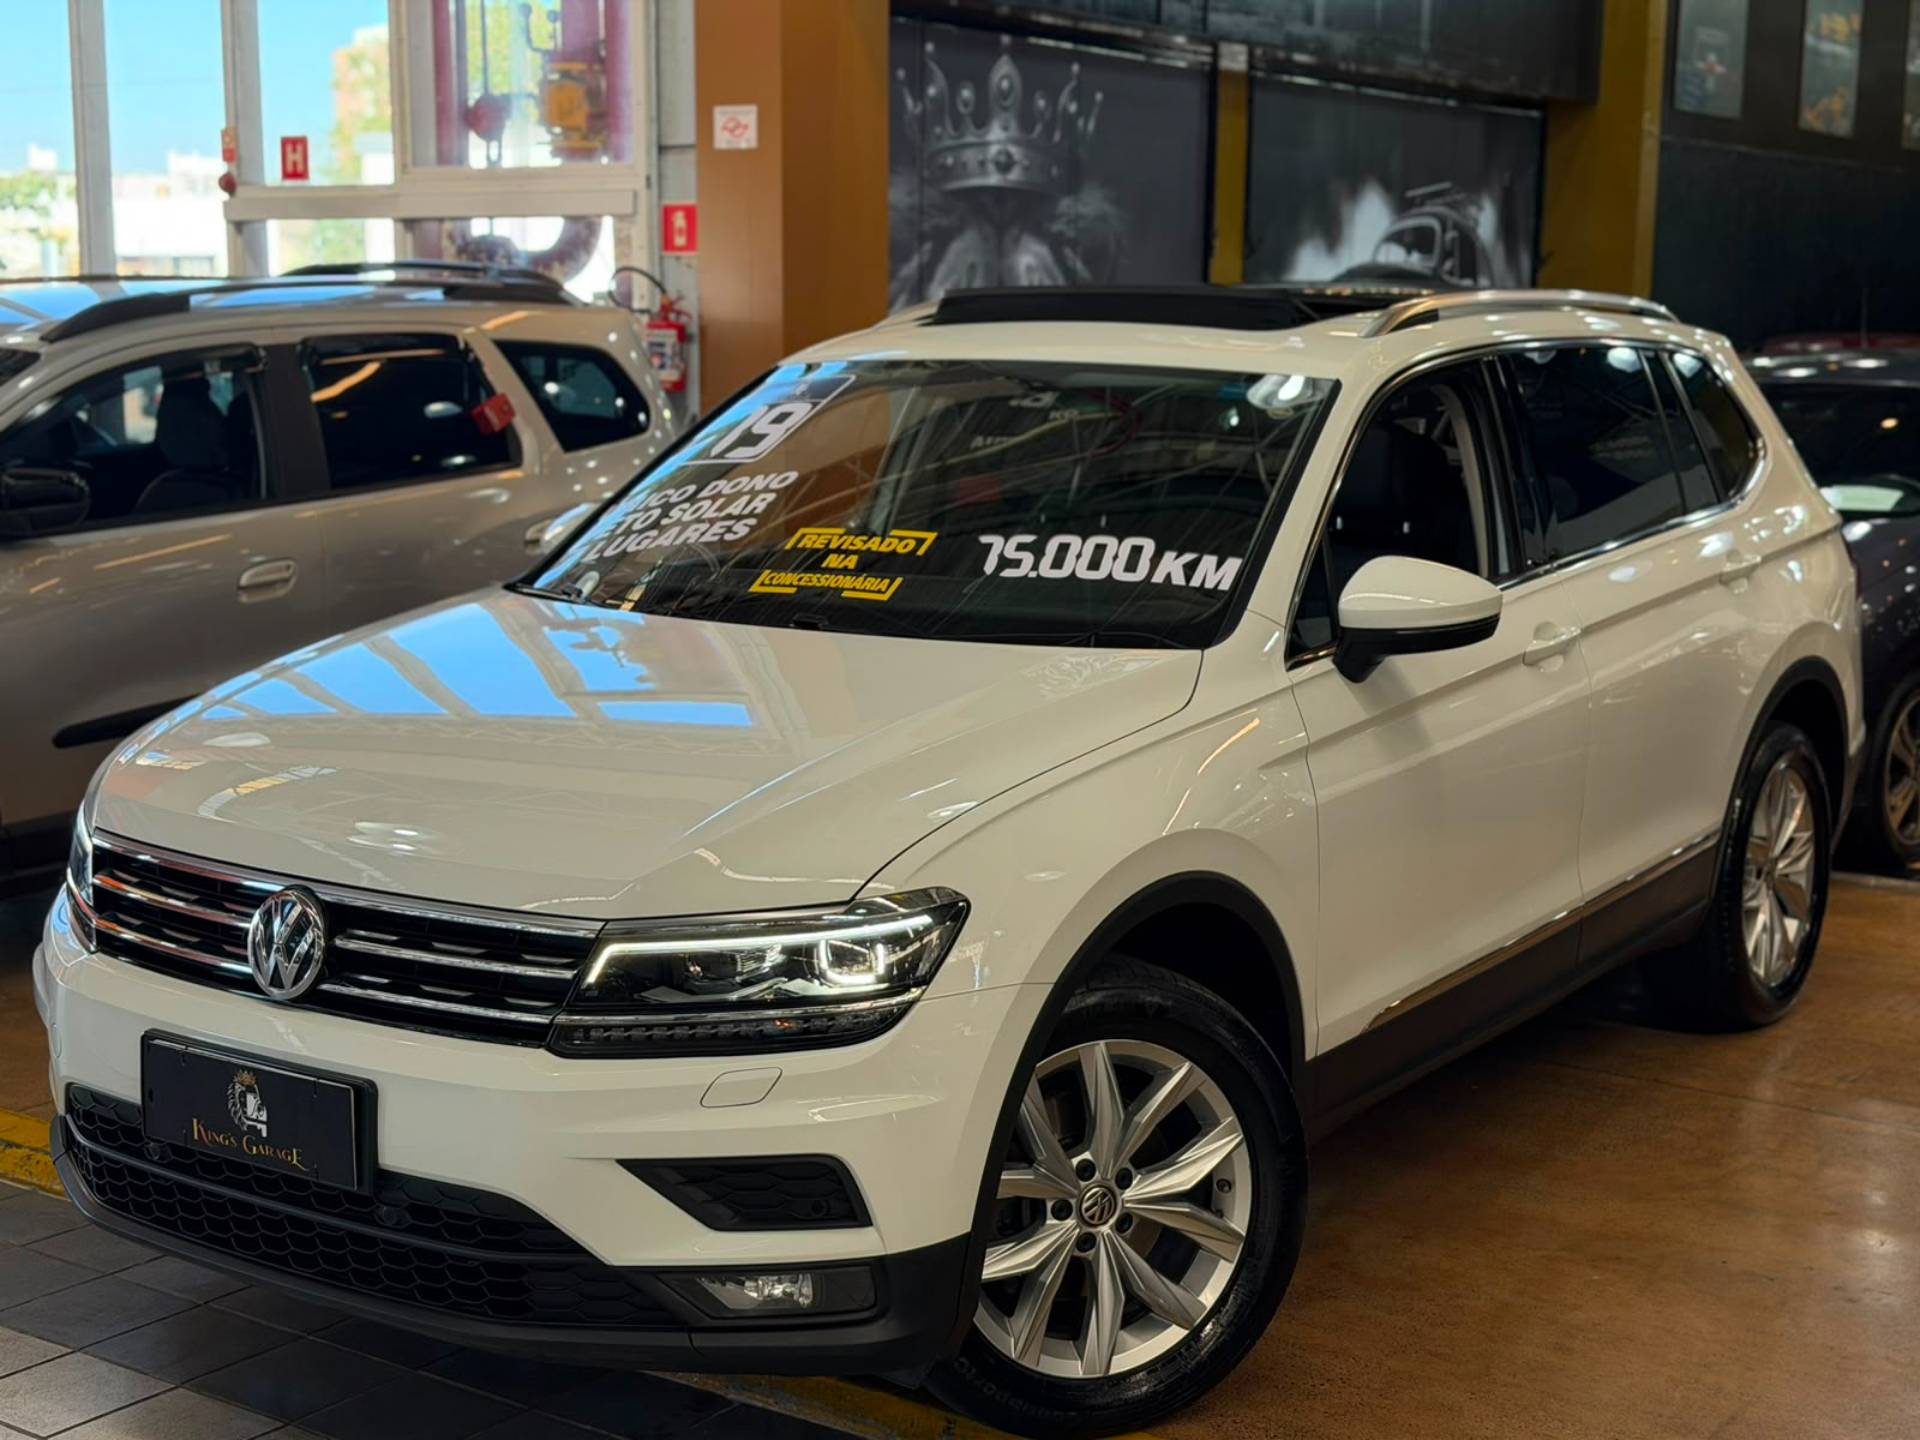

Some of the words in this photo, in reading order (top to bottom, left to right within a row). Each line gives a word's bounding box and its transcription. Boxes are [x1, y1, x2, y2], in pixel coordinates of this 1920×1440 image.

[697, 471, 799, 499] DONO
[661, 492, 778, 526] SOLAR
[581, 518, 758, 564] LUGARES
[796, 534, 917, 554] REVISADO
[820, 553, 860, 570] NA
[978, 534, 1156, 582] 75.000
[1150, 550, 1244, 591] KM
[763, 571, 892, 592] CONCESSIONÁRIA
